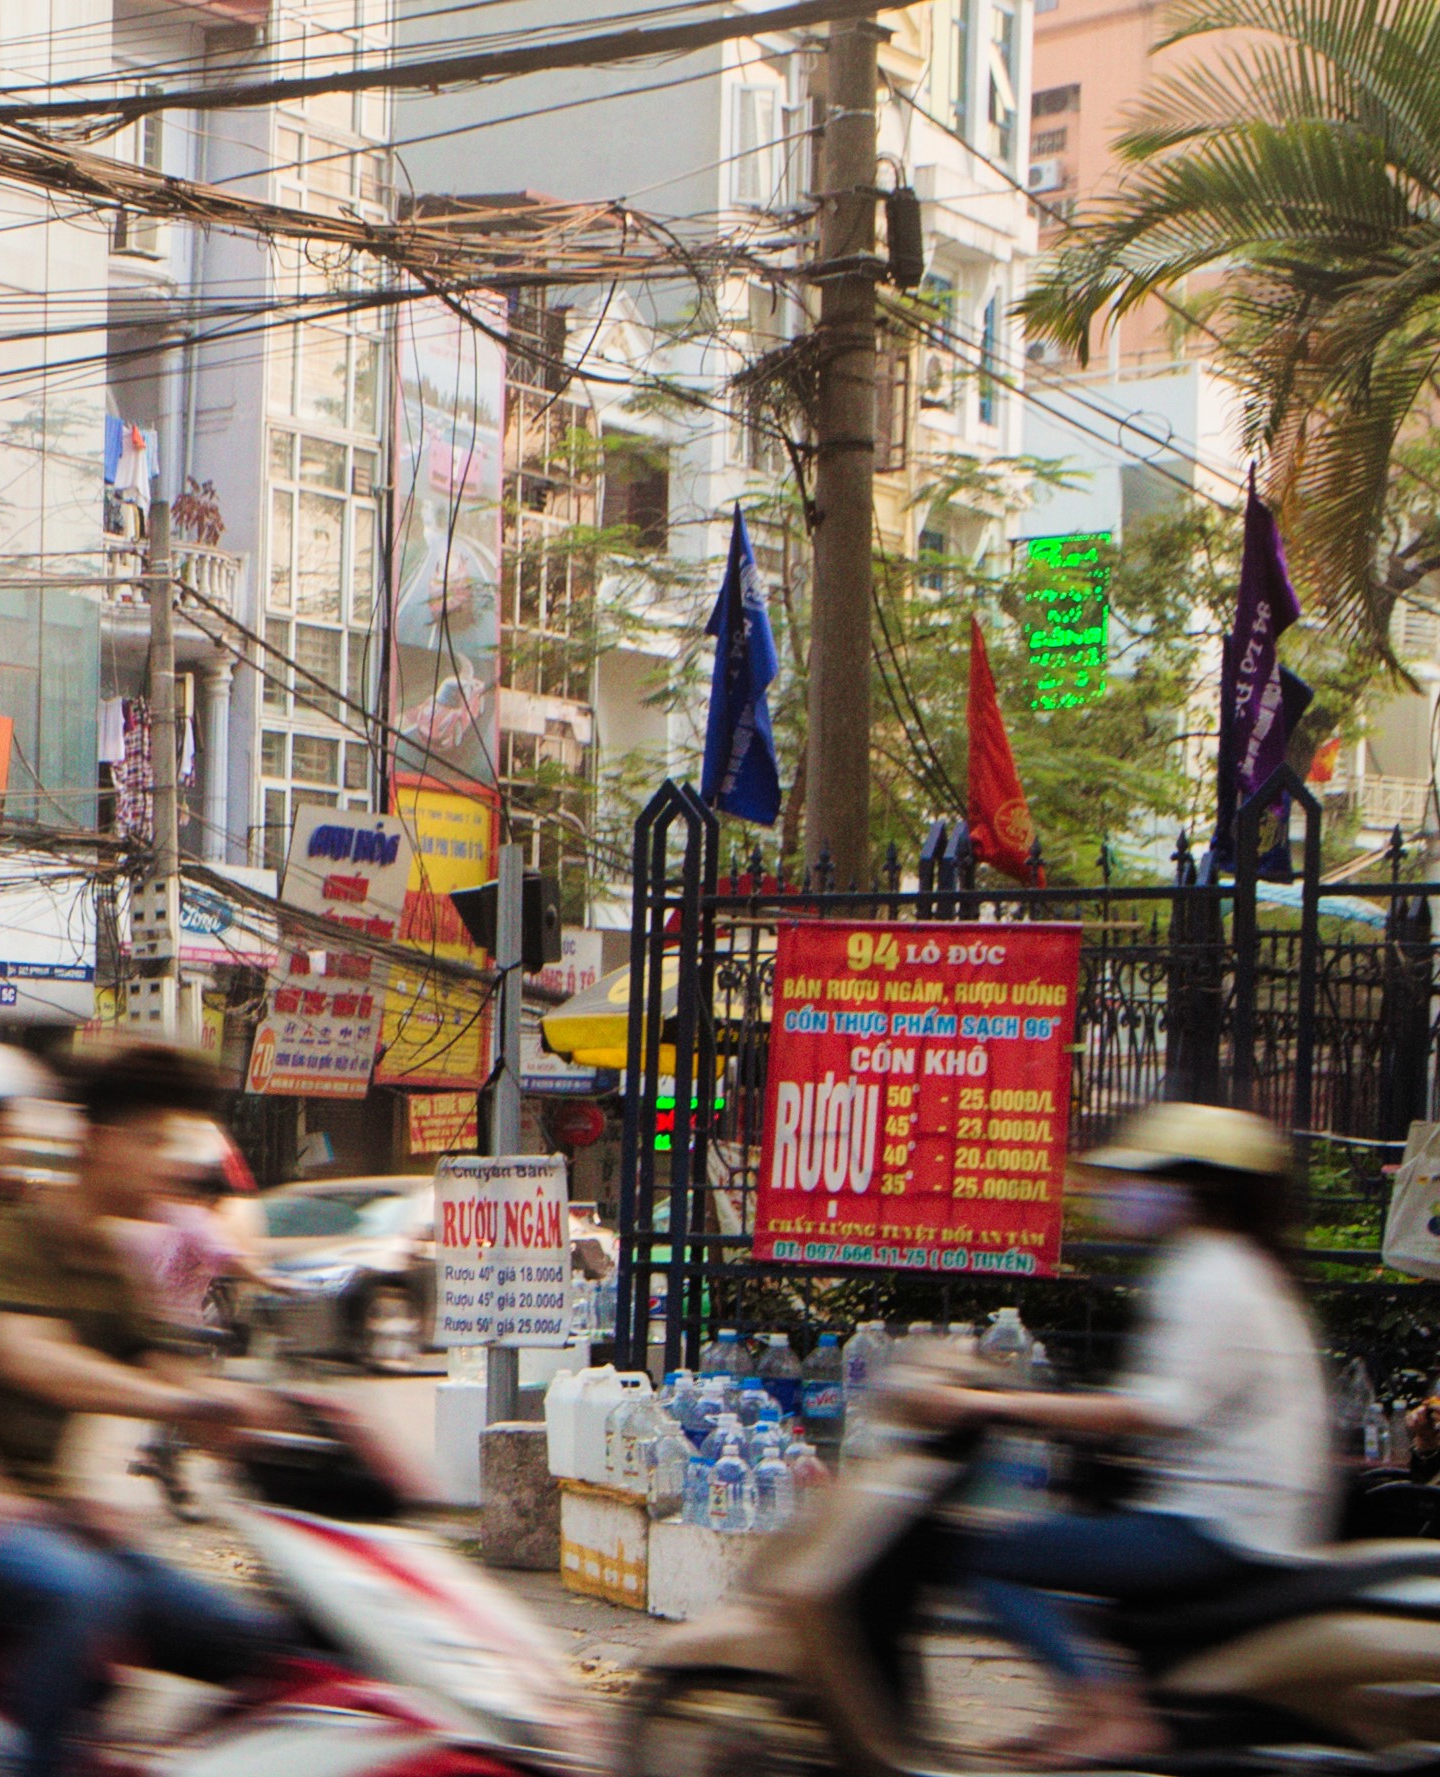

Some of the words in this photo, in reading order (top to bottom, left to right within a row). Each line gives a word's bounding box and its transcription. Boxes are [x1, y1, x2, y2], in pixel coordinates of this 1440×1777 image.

[847, 932, 900, 971] 94
[906, 939, 942, 965] LÒ
[947, 940, 1006, 966] ĐÚC
[1, 988, 16, 1002] 5C
[784, 978, 822, 1000] BÁN
[827, 980, 879, 1005] RƯỢU
[885, 979, 948, 1006] NGÂM,
[955, 981, 1007, 1008] RƯỢU
[1011, 977, 1068, 1006] UỐNG
[834, 1011, 886, 1039] THỰC
[962, 1016, 1019, 1042] SẠCH
[924, 1046, 988, 1076] KHÔ
[771, 1071, 880, 1218] RƯỢU
[443, 1195, 498, 1260] RƯỢU
[504, 1186, 563, 1249] NGÂM
[979, 1229, 1004, 1244] AN
[445, 1266, 475, 1284] Rượu
[498, 1268, 516, 1285] giá
[520, 1266, 563, 1283] 18.000đ
[445, 1292, 475, 1310] Rượu
[498, 1294, 516, 1311] giá
[519, 1292, 564, 1309] 20.000đ
[444, 1317, 474, 1335] Rượu
[497, 1319, 515, 1336] giá
[517, 1317, 562, 1334] 25.000đ
